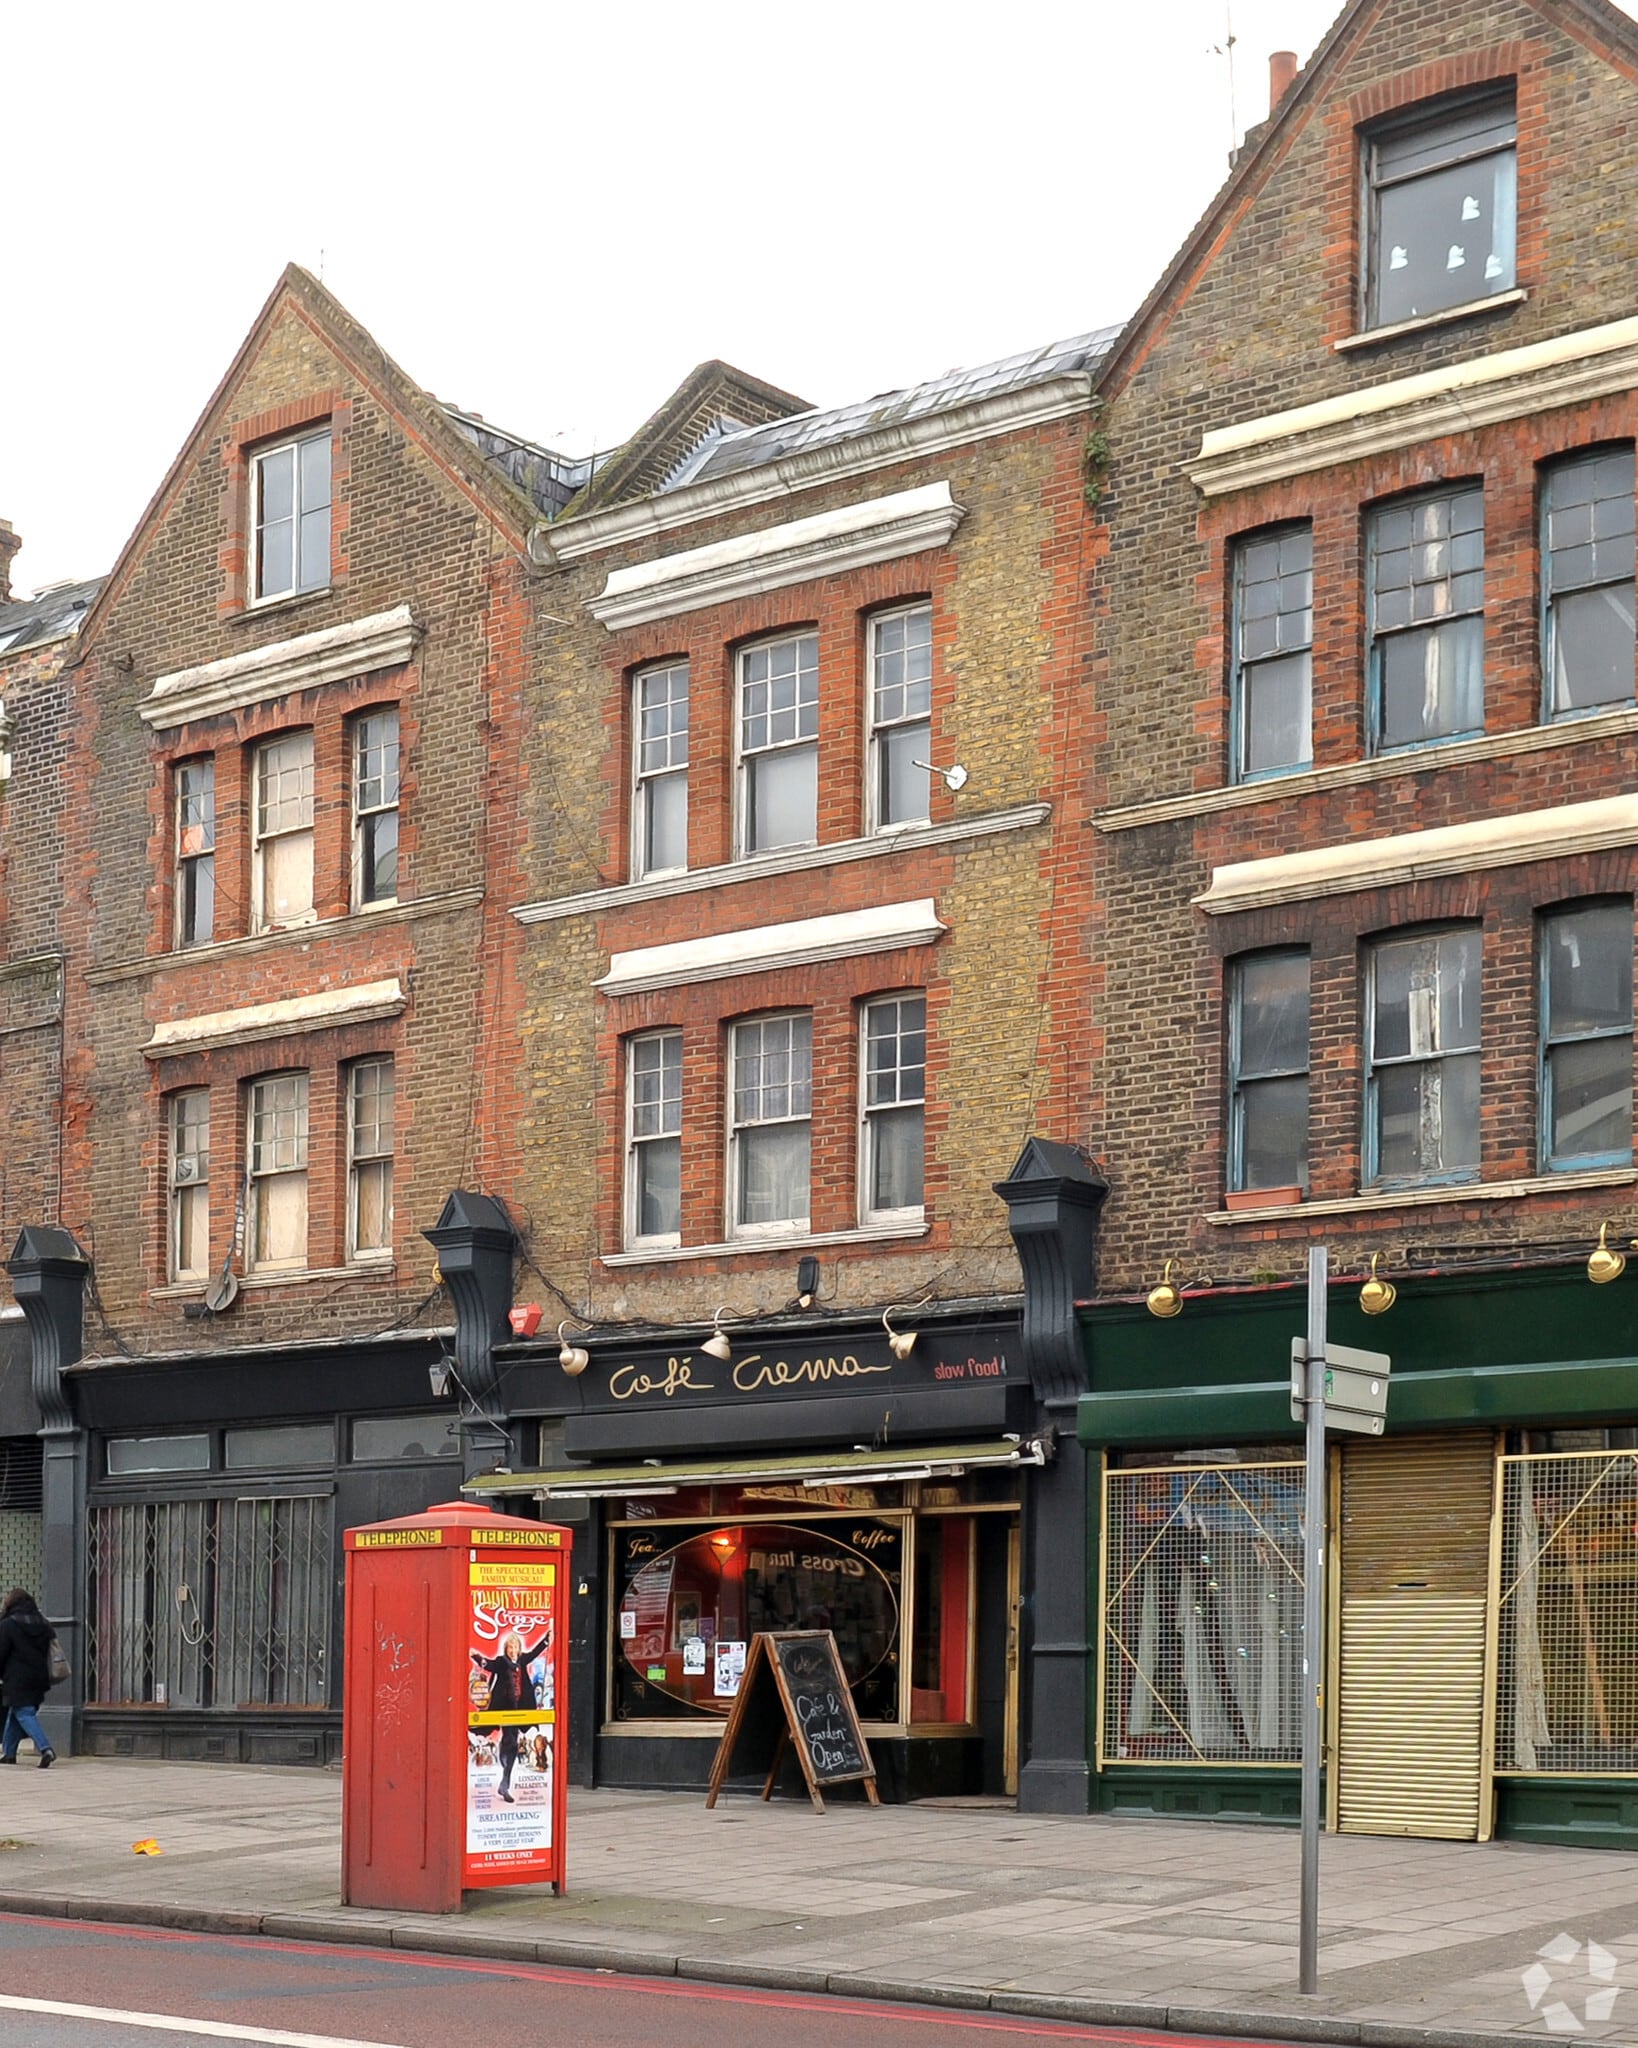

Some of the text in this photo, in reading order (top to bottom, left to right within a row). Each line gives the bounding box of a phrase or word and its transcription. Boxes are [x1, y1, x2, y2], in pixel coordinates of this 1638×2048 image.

[609, 1354, 892, 1399] Café Crema
[934, 1357, 999, 1380] slow food
[361, 1530, 435, 1546] TELEPHONE
[477, 1530, 555, 1545] TELEPHONE
[852, 1530, 896, 1549] Coffee
[480, 1566, 545, 1575] THE SPECTACULAR
[481, 1575, 507, 1583] FAMILY
[471, 1590, 551, 1609] TOMMY STEELE
[812, 1741, 845, 1771] Open
[514, 1782, 548, 1790] PALLADIUM
[518, 1775, 545, 1783] LONDON
